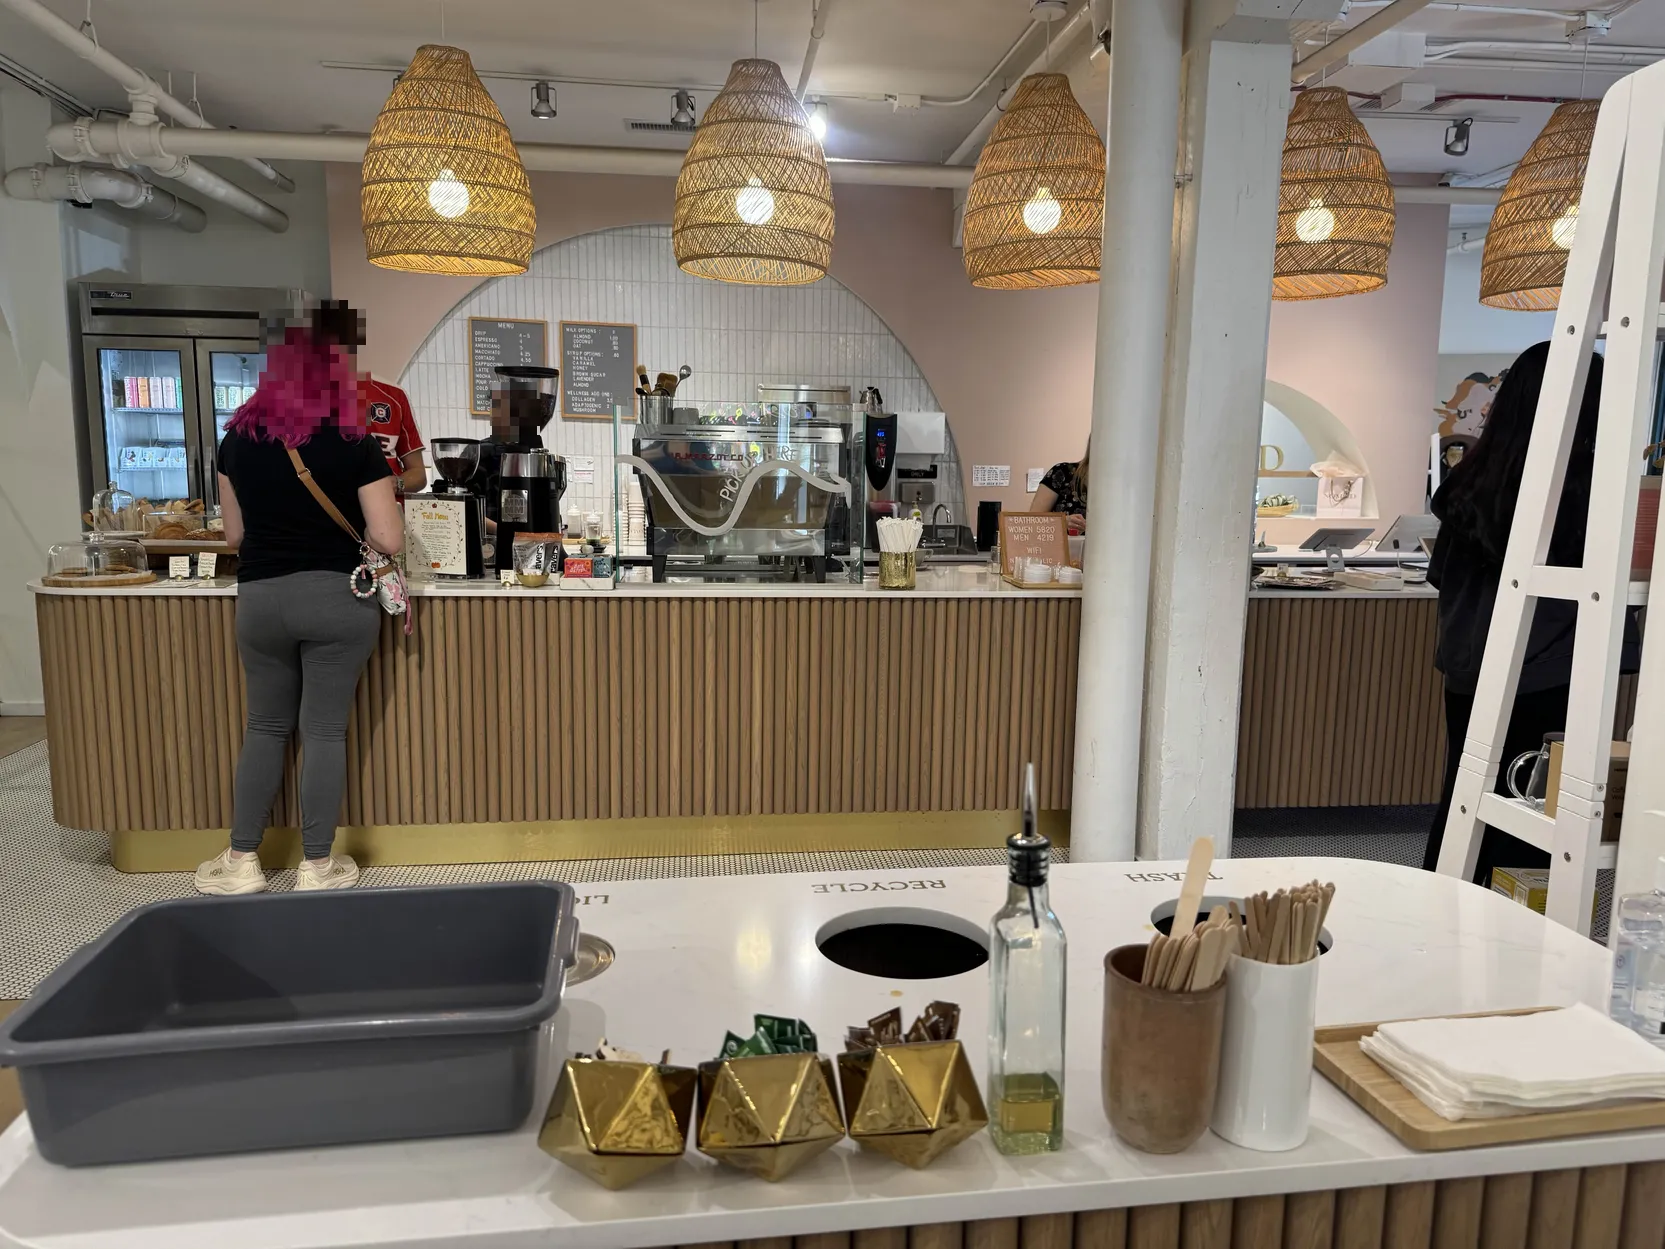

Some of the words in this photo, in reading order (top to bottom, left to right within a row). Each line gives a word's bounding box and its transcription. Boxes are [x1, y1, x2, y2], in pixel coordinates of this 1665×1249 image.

[720, 468, 745, 502] PICK
[1124, 872, 1224, 882] TASH
[812, 880, 946, 894] RECYCLE
